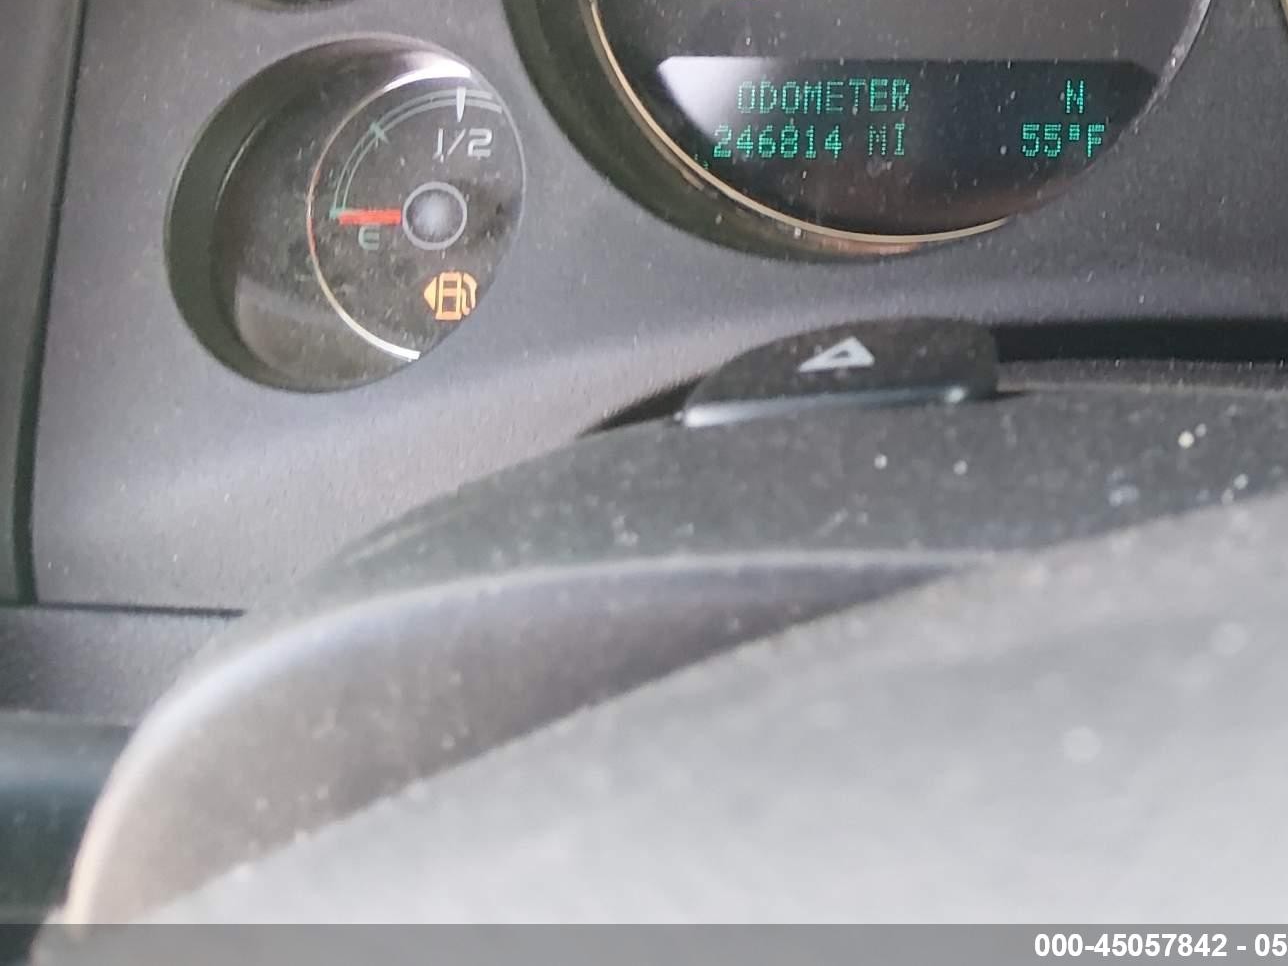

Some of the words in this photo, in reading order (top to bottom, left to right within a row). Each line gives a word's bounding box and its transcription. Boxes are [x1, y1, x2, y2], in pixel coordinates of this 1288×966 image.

[736, 78, 912, 116] ODOMETER
[1065, 79, 1087, 115] N
[433, 128, 493, 158] 1/2
[712, 125, 843, 159] 246814
[868, 123, 906, 158] MI
[358, 225, 380, 251] E
